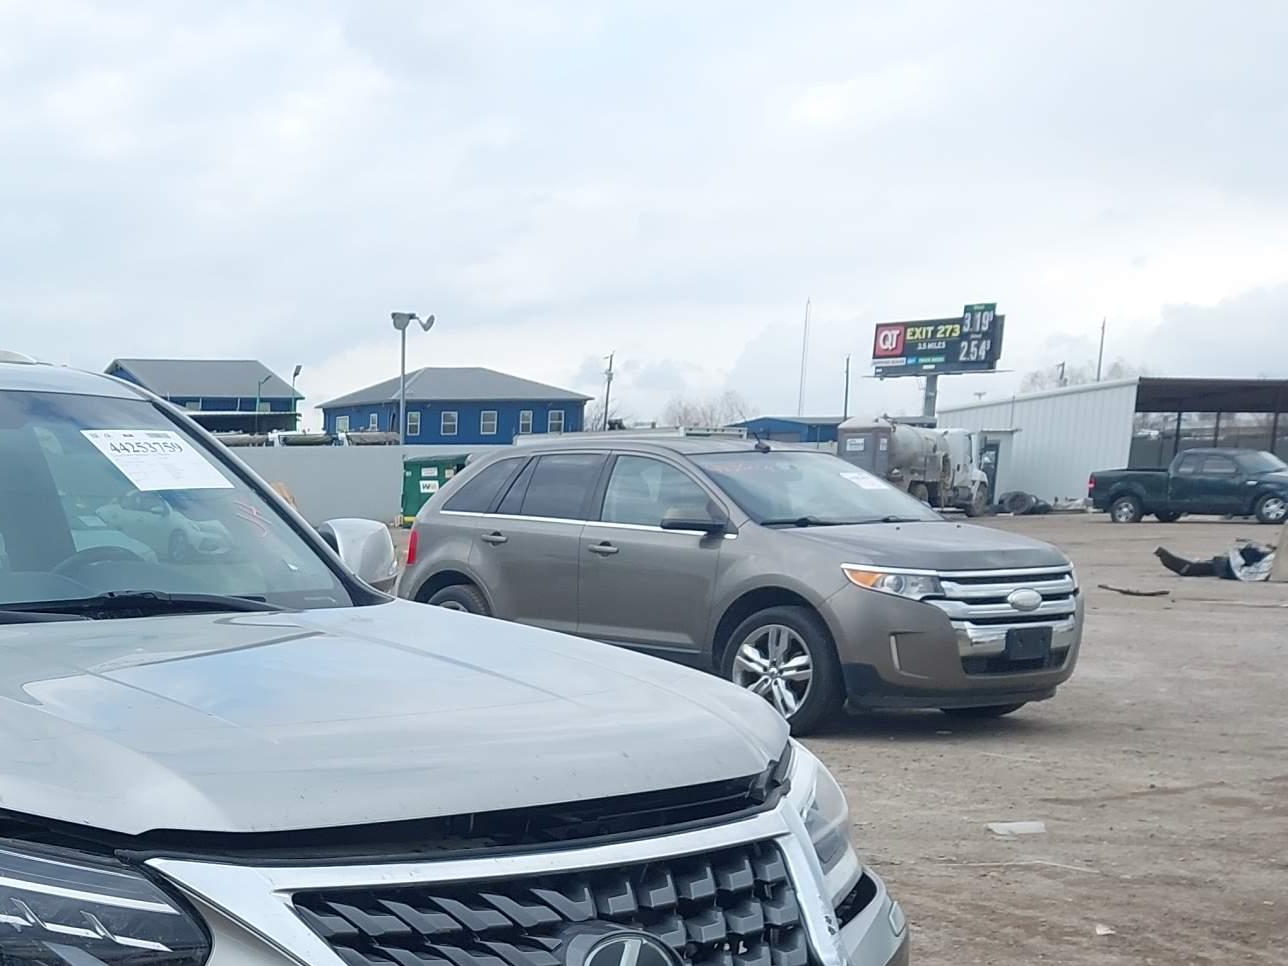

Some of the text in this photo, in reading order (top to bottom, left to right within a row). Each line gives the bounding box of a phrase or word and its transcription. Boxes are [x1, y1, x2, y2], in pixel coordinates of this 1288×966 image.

[905, 324, 960, 340] EXIT 273
[879, 329, 900, 350] QT
[927, 341, 946, 349] MILES
[110, 441, 183, 453] 44253759
